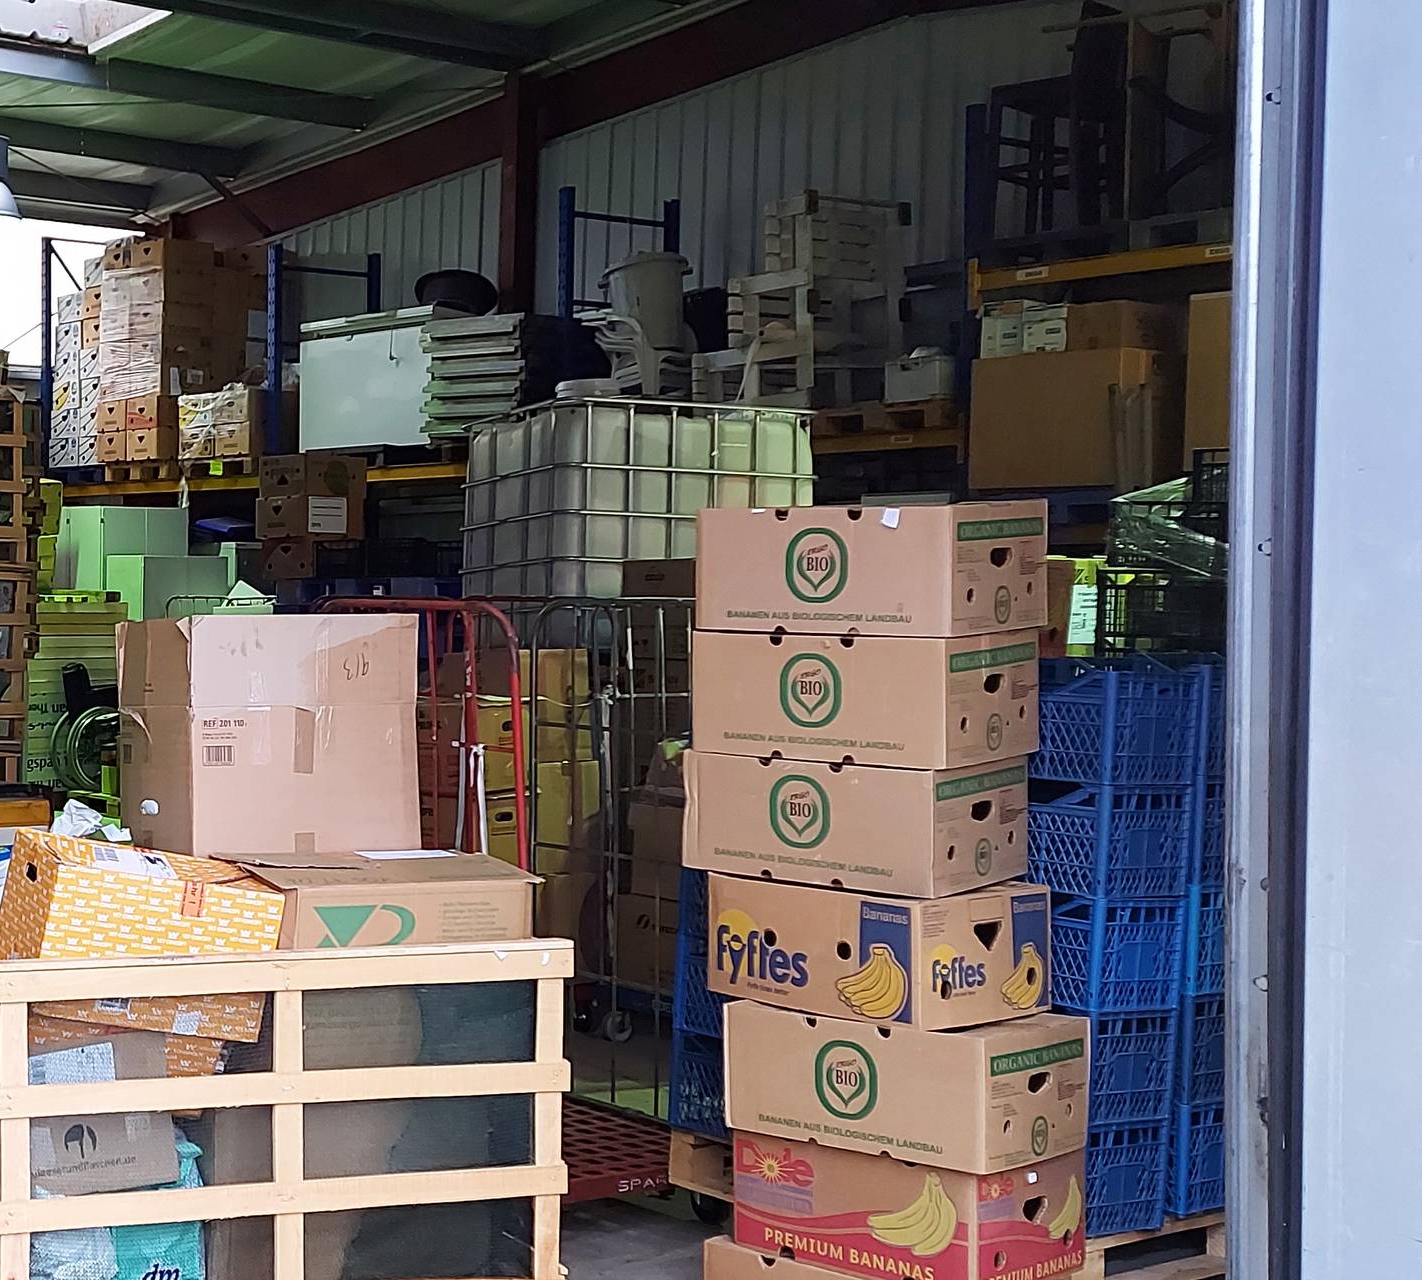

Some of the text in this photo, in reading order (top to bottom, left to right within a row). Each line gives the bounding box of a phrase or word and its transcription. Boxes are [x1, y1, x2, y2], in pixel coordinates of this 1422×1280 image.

[806, 557, 828, 572] BIO
[772, 611, 790, 621] AUS
[866, 613, 912, 624] LANDBAU
[800, 680, 822, 696] BIO
[203, 719, 217, 728] REF
[219, 719, 231, 728] 201
[767, 734, 786, 744] AUS
[789, 801, 811, 818] BIO
[758, 852, 775, 863] AUS
[863, 906, 908, 925] Bananas
[993, 1051, 1040, 1073] ORGANIC
[836, 1069, 858, 1087] BIO
[758, 1113, 943, 1155] BANANEN AUS BIOLOGISCHEM LANDBAU
[764, 1227, 935, 1280] PREMIUM BANANAS
[1036, 1249, 1083, 1279] BANANAS
